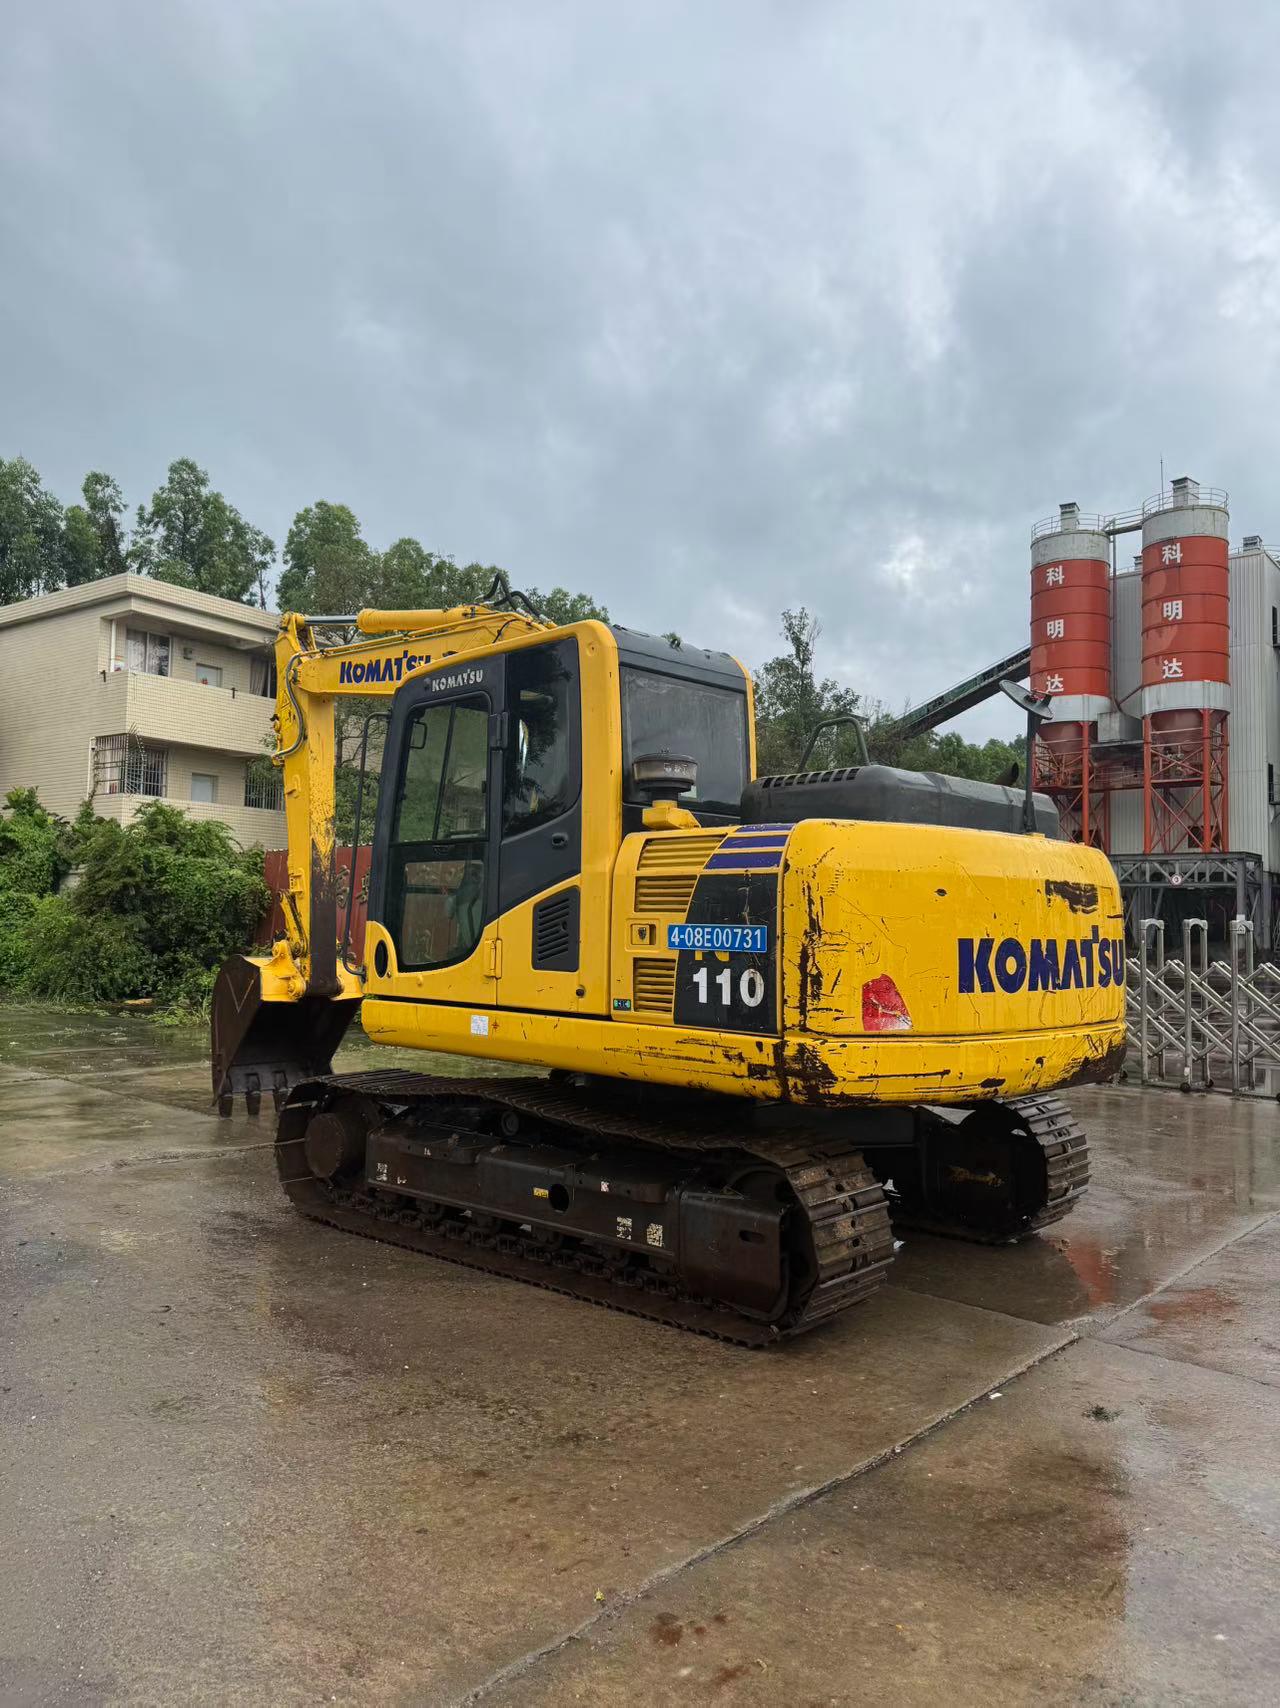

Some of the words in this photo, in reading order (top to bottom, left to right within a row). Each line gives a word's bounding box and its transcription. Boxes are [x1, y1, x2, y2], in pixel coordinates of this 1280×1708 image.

[1046, 565, 1064, 693] 科明达
[1162, 543, 1183, 678] 科明达
[432, 669, 483, 691] KOMATSU
[671, 927, 761, 949] 4-08E00731
[958, 925, 1124, 993] KOMATSU
[693, 967, 764, 1007] 110
